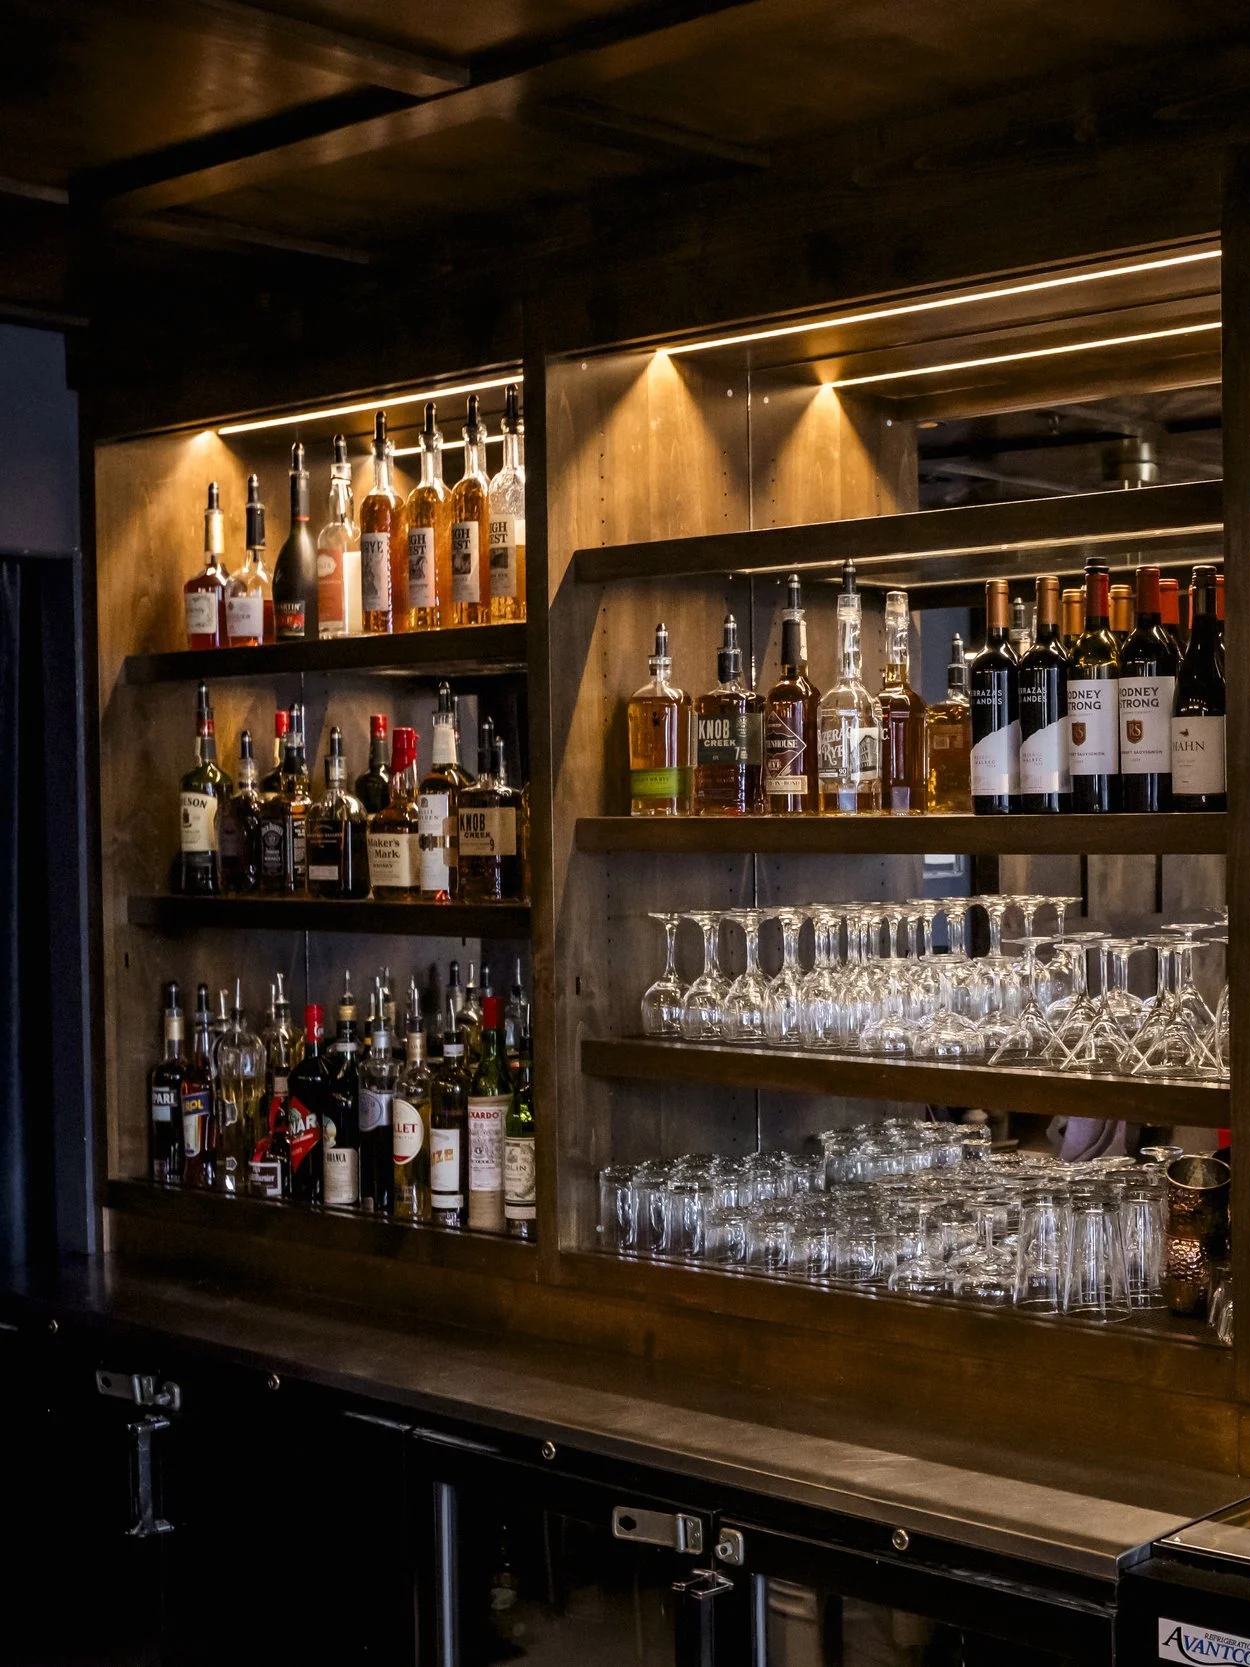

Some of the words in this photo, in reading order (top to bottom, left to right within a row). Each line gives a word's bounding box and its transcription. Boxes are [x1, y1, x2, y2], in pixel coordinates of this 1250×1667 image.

[1067, 690, 1102, 699] ODNEY
[1067, 701, 1102, 711] TRONG
[698, 719, 730, 739] KNOB
[703, 739, 737, 747] CREEK
[459, 812, 486, 832] KNOB
[367, 838, 400, 849] Maker's
[489, 838, 495, 851] 9
[374, 849, 400, 859] Mark
